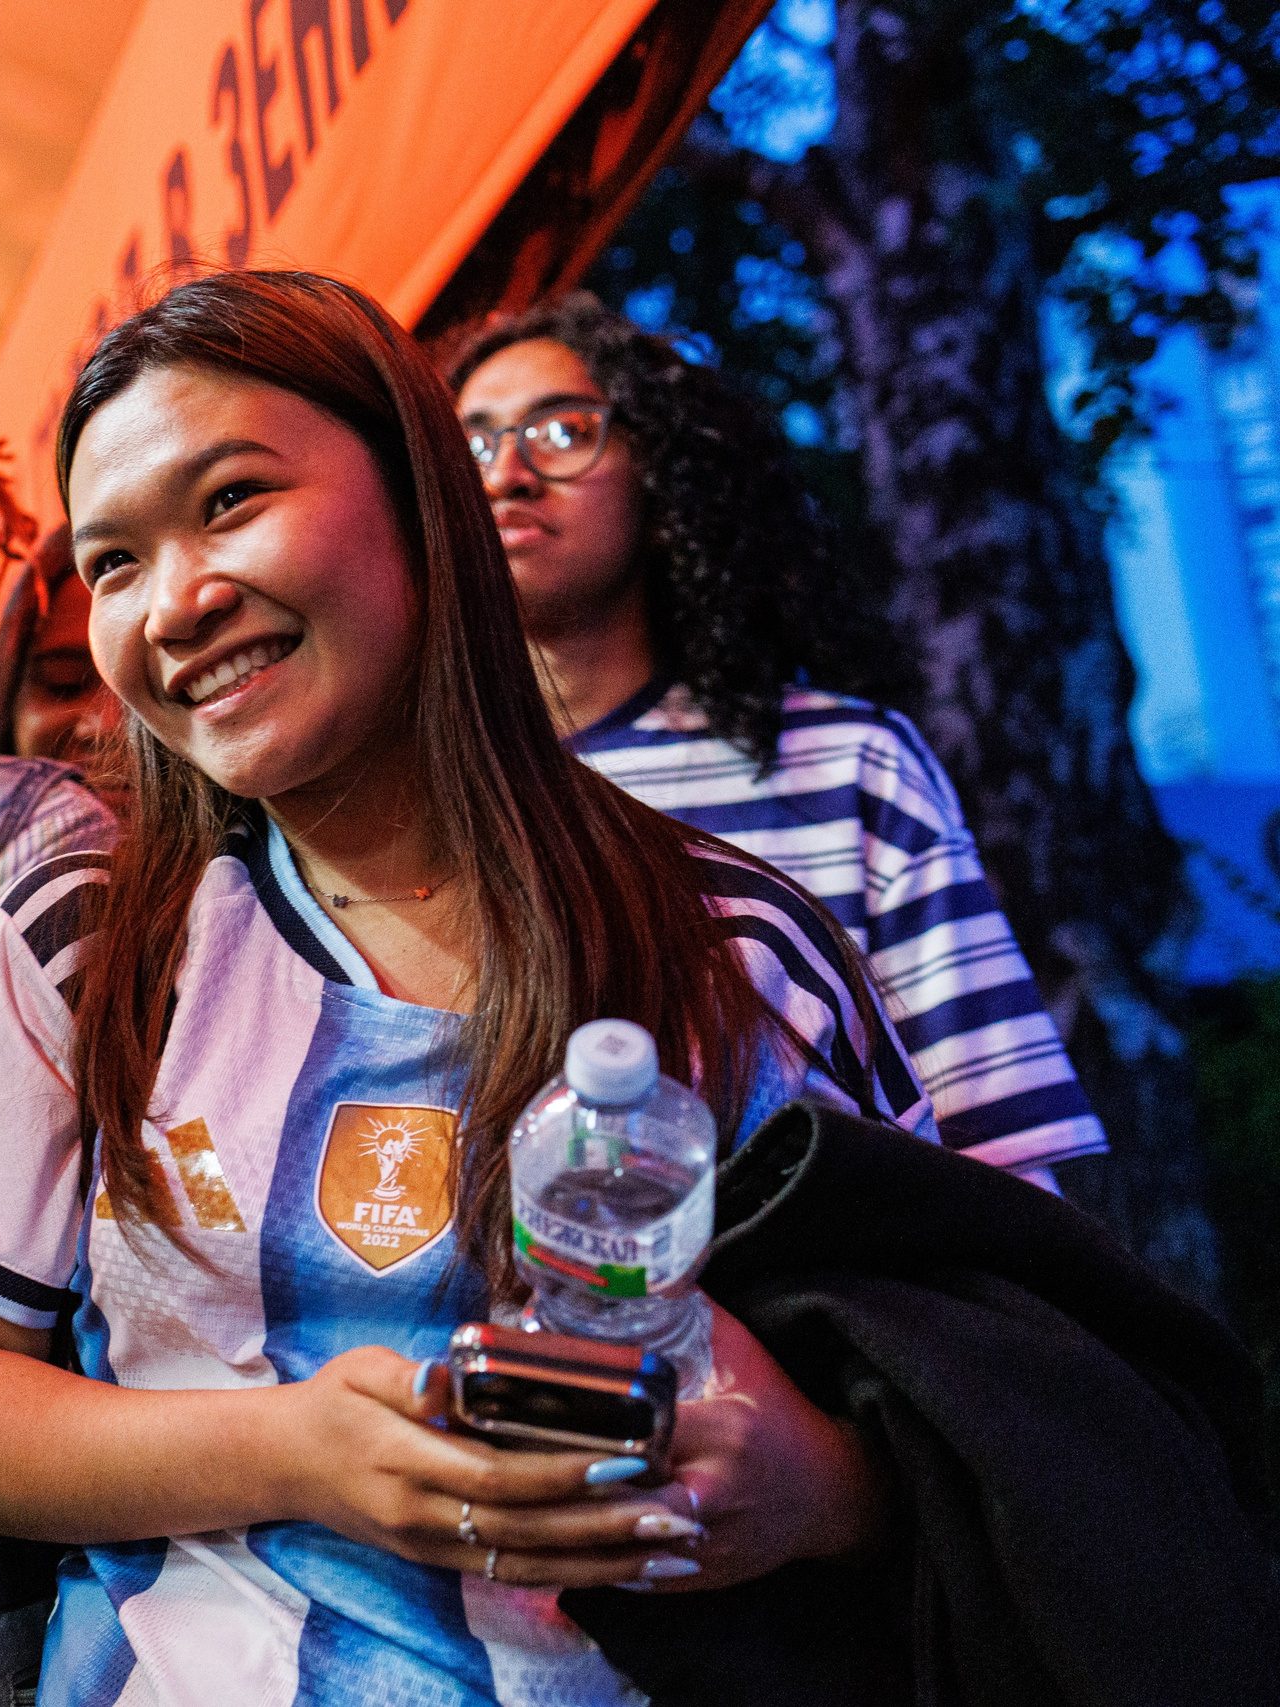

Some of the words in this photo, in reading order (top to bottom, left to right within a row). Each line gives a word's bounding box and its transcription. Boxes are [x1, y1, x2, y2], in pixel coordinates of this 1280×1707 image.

[336, 1221, 372, 1232] WORLD
[372, 1224, 430, 1237] CHAMPIONS
[361, 1232, 401, 1249] 2022
